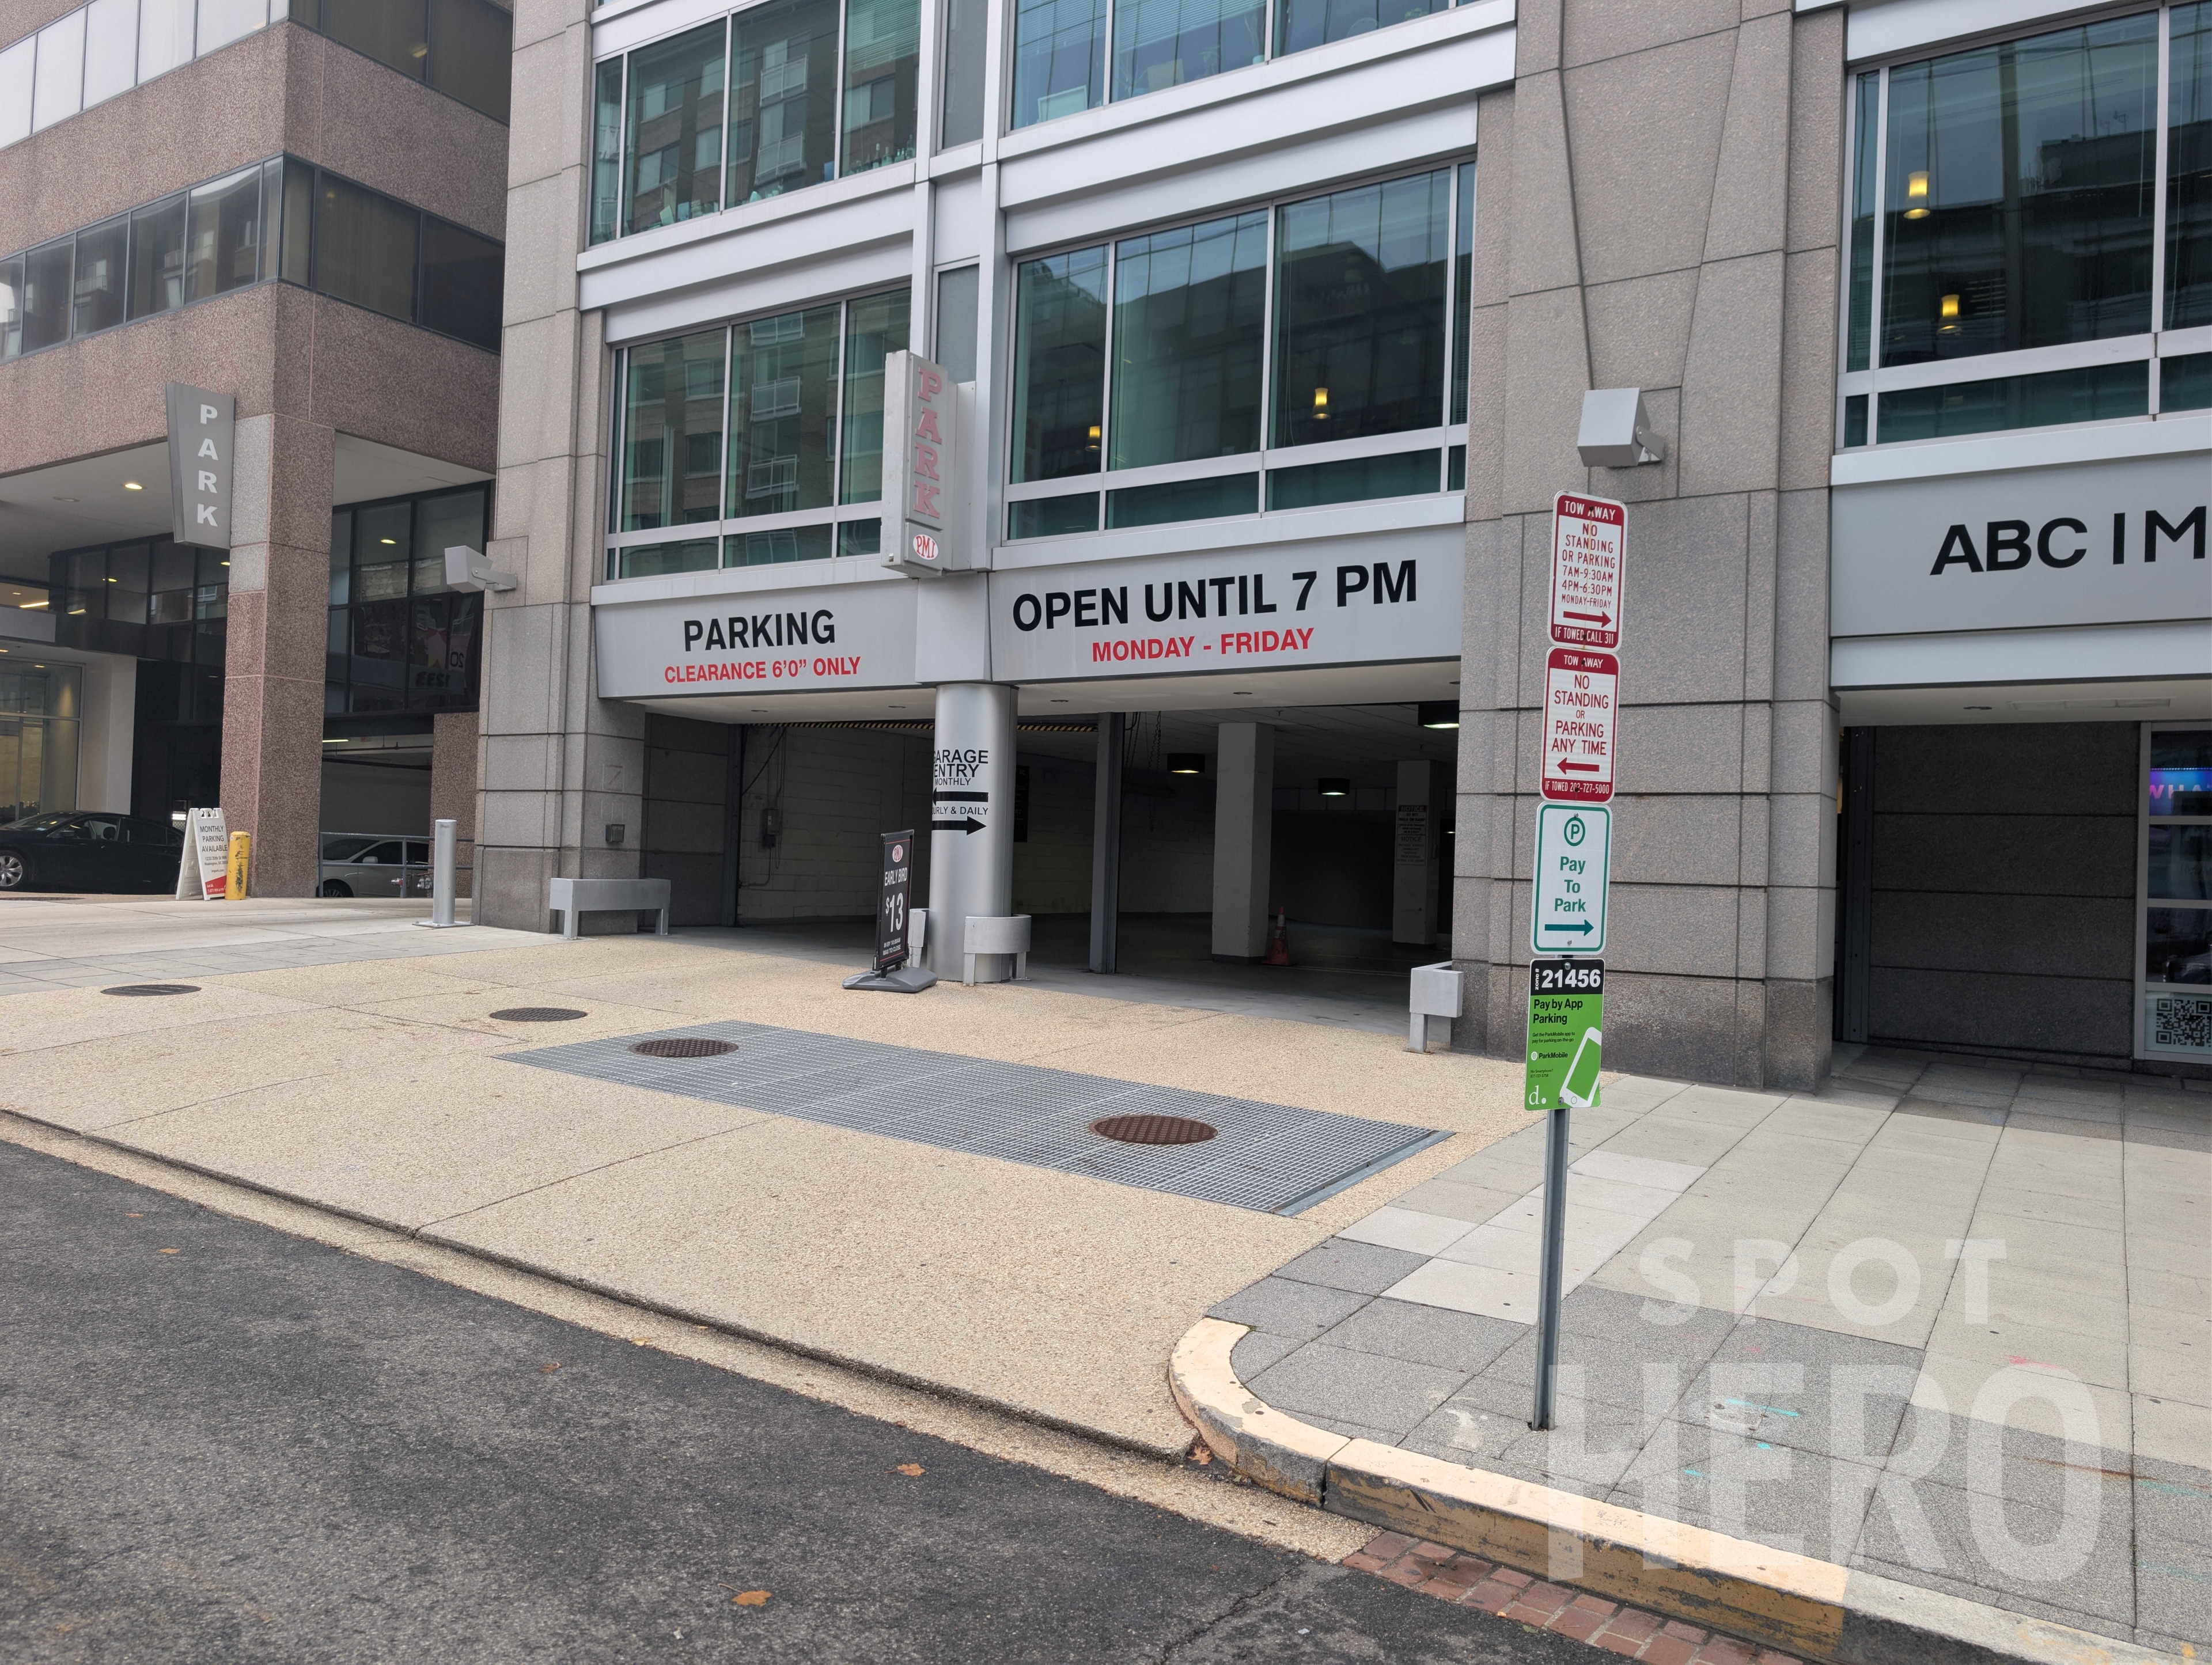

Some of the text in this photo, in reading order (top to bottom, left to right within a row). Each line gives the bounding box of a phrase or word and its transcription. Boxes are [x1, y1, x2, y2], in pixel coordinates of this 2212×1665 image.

[914, 367, 942, 518] PARK
[196, 404, 218, 527] PARK
[1565, 500, 1616, 521] TOW AWAY
[1582, 523, 1597, 536] NO
[916, 535, 936, 559] PMI
[1565, 534, 1613, 553] STANDING
[1930, 517, 2088, 575] ABC
[1562, 549, 1615, 568] OR PARKING
[1563, 565, 1613, 582] 7AM-9:30AM
[1013, 559, 1417, 632] OPEN UNTIL 7 PM
[1562, 579, 1612, 596] 4PM-6:30PM
[1561, 594, 1611, 609] MONDAY-FRIDAY
[684, 609, 835, 652] PARKING
[1555, 627, 1614, 644] IF TOWED CALL 311
[1092, 635, 1196, 662] MONDAY
[1220, 627, 1315, 655] FRIDAY
[664, 661, 767, 684] CLEARANCE
[813, 656, 861, 676] ONLY
[1564, 655, 1604, 669] TOW AWAY
[1574, 674, 1590, 689] NO
[1554, 690, 1609, 709] STANDING
[1576, 710, 1585, 719] OR
[1555, 720, 1604, 738] PARKING
[1551, 738, 1607, 755] ANY TIME
[934, 764, 980, 777] ENTRY
[1545, 781, 1609, 794] IF TOWED 202-727-5000
[950, 806, 957, 814] &
[960, 807, 988, 815] DAILY
[202, 844, 228, 852] AVAILABLE
[894, 847, 902, 860] PMI
[1559, 856, 1586, 875] Pay
[884, 867, 908, 886] EARLY BIRD
[1564, 879, 1581, 893] To
[885, 892, 904, 932] $13
[1554, 898, 1586, 912] Park
[893, 945, 901, 953] CLOSE
[1541, 969, 1601, 988] 21456
[1533, 998, 1583, 1011] Pay by App
[1533, 1013, 1567, 1025] Parking
